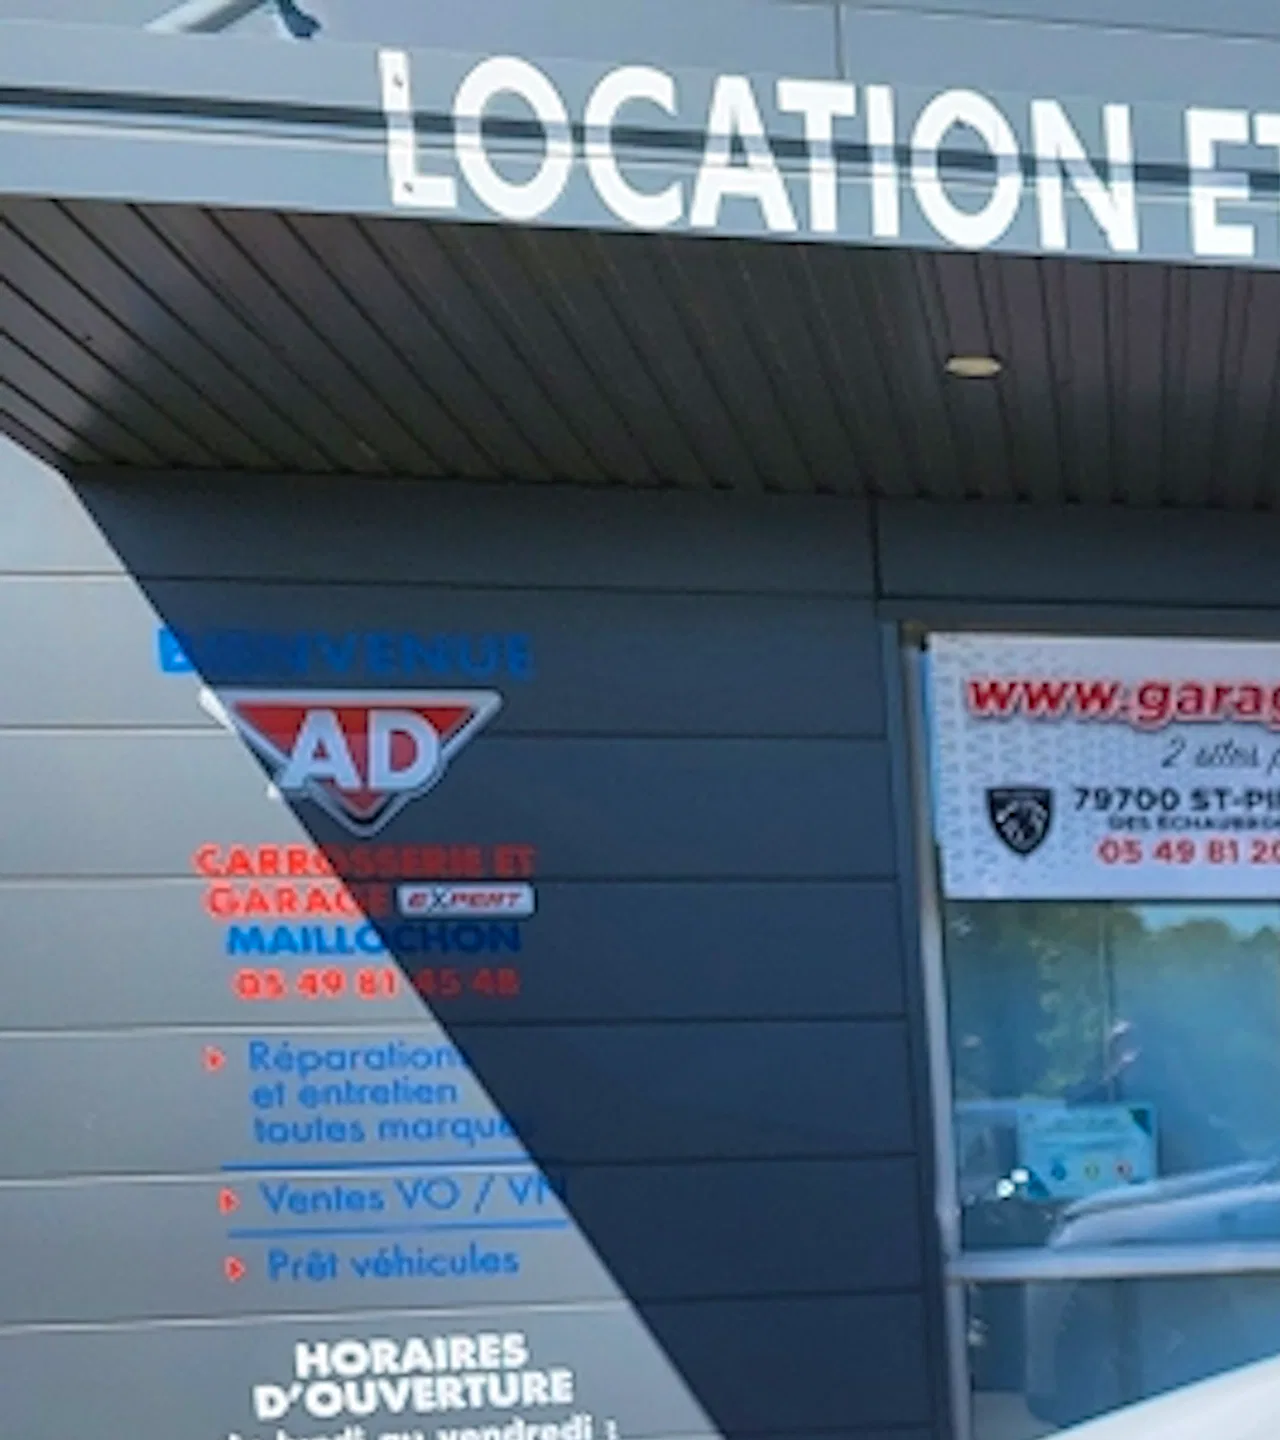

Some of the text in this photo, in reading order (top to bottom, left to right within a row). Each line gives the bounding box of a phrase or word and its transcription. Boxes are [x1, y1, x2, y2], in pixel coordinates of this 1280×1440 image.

[378, 49, 1142, 254] LOCATION
[157, 627, 536, 679] BNVENUE
[278, 709, 443, 791] AD
[1073, 785, 1182, 813] 79700
[194, 844, 536, 877] CARROSSERIE ET
[1096, 838, 1144, 866] 05
[1151, 839, 1197, 865] 49
[1206, 839, 1241, 865] 81
[207, 882, 387, 918] GARAGE
[226, 924, 522, 955] MAILLOCHON
[235, 967, 288, 999] 05
[295, 967, 346, 999] 49
[354, 967, 400, 999] 81
[251, 1076, 459, 1110] et entretien
[254, 1115, 366, 1144] toutes
[260, 1180, 385, 1215] Ventes
[393, 1176, 462, 1211] VO
[268, 1243, 520, 1283] Prêt véhicules
[294, 1332, 530, 1379] HORAIRES
[251, 1367, 575, 1421] D'OUVERTURE
